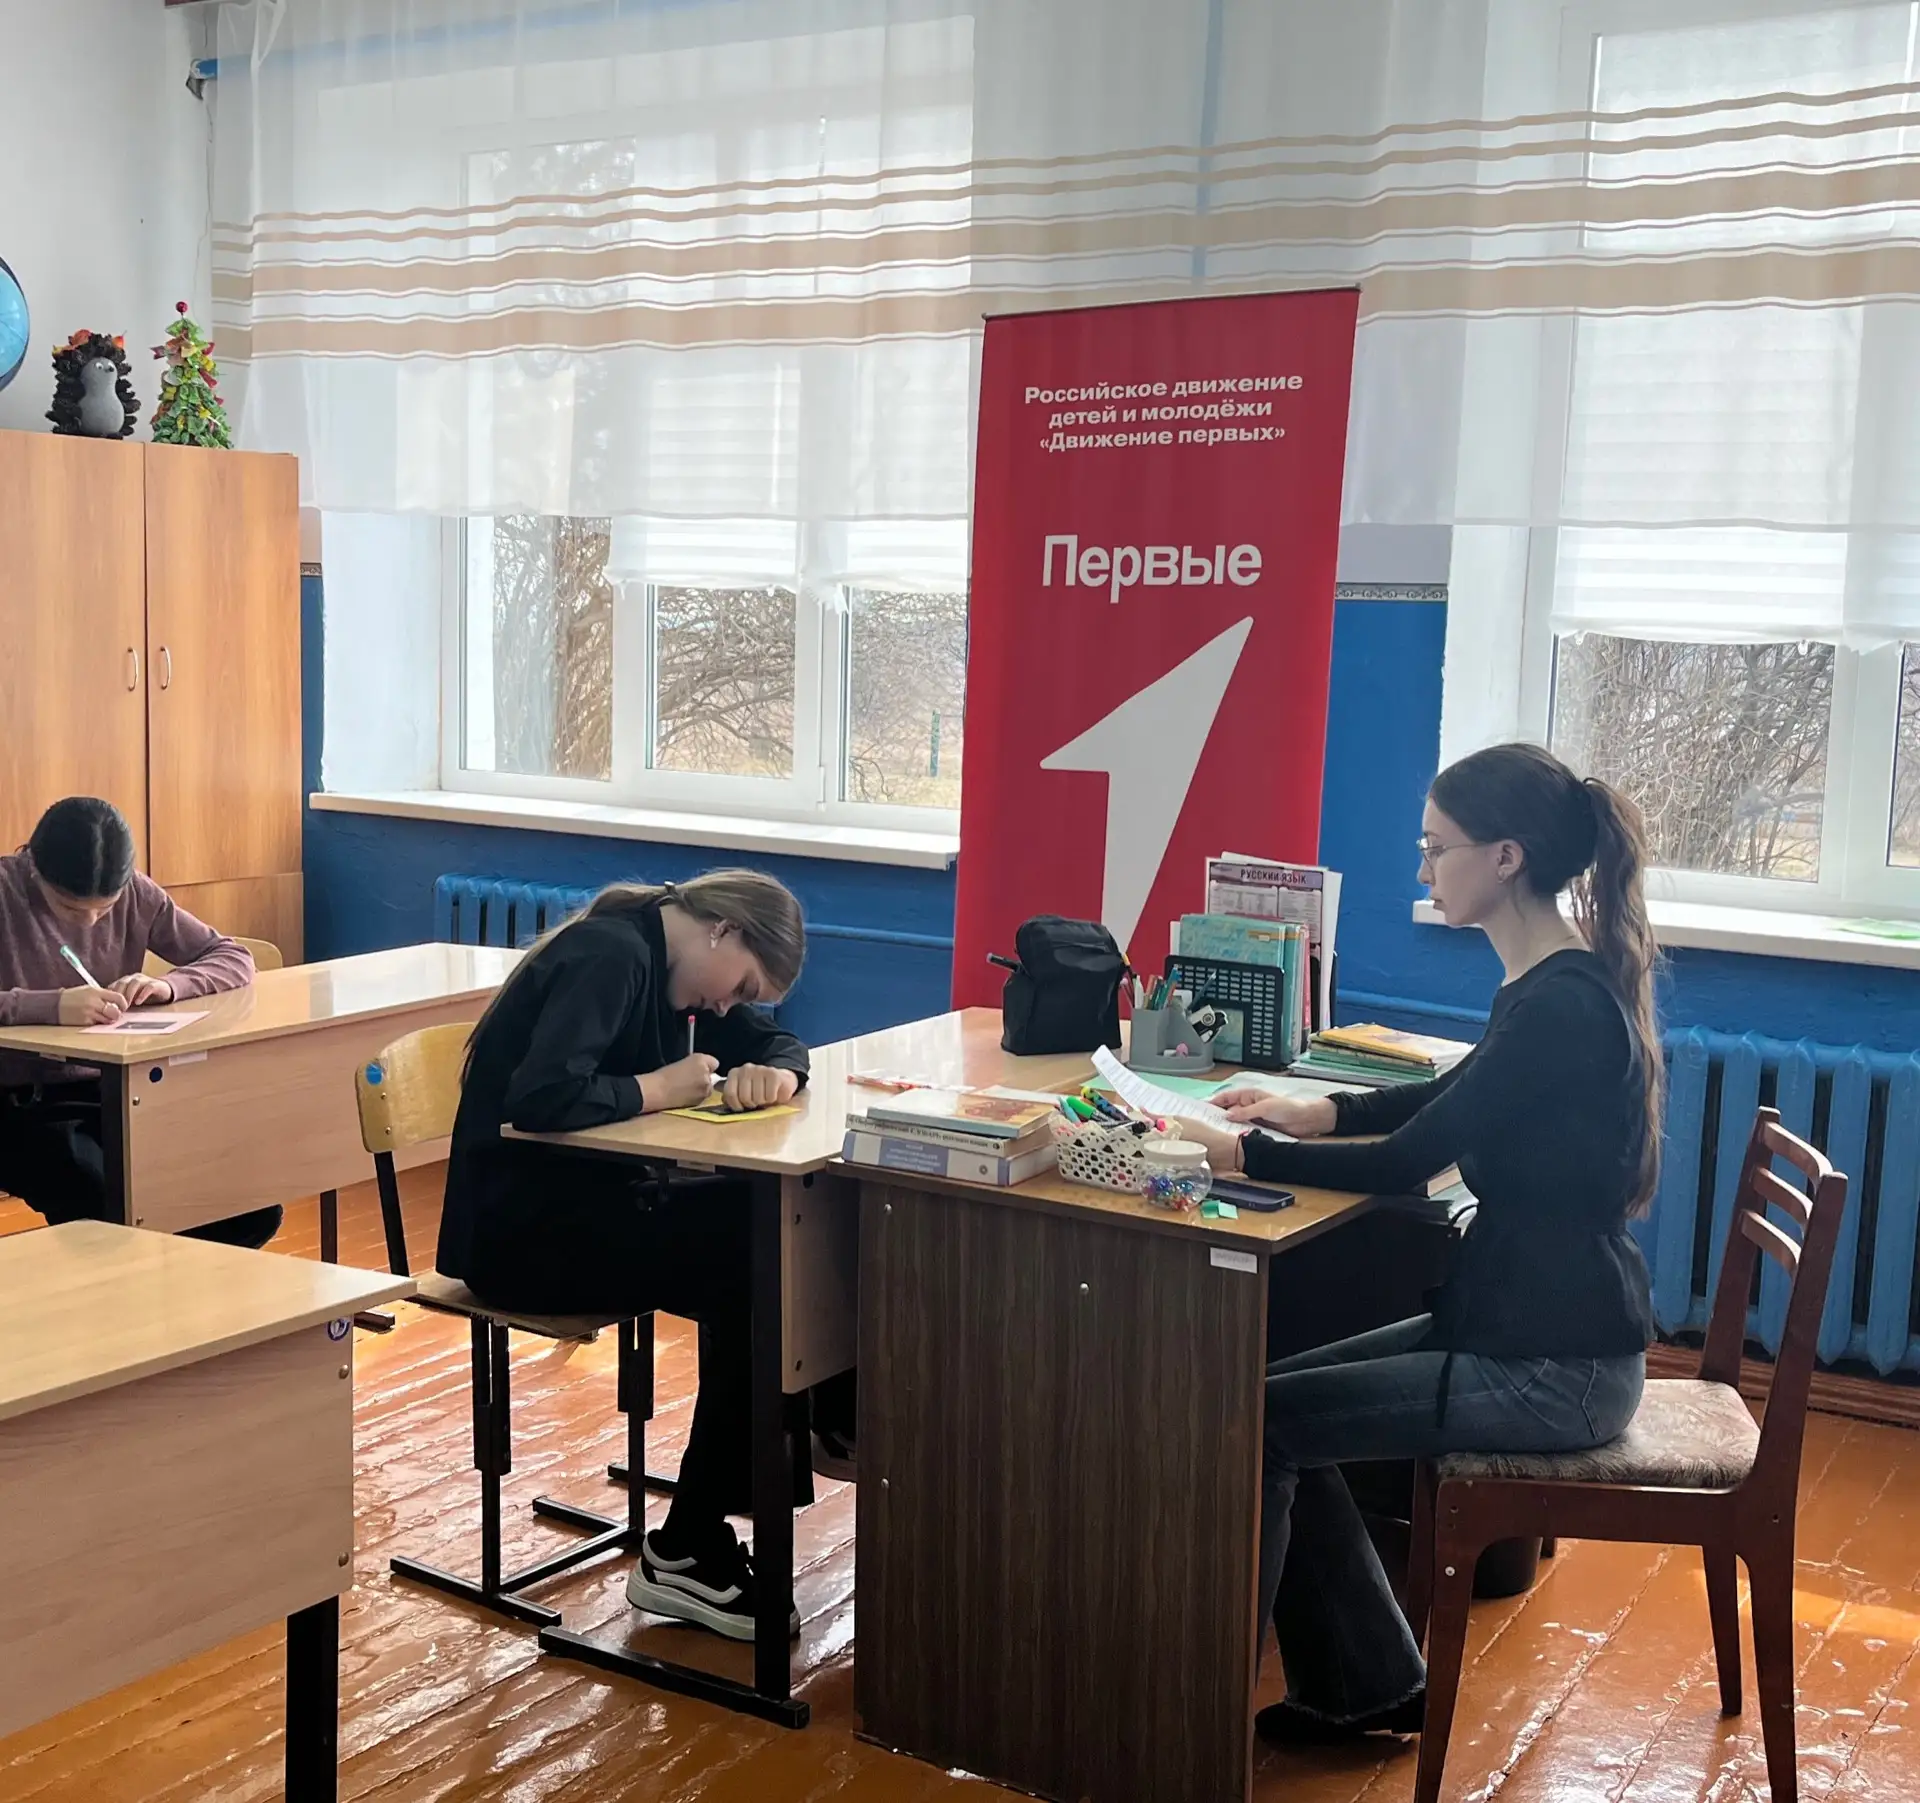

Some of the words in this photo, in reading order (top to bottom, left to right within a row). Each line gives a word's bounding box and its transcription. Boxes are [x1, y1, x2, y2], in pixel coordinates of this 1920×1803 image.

[1025, 382, 1167, 403] Российское
[1172, 375, 1303, 398] движение
[1049, 405, 1116, 428] детей
[1122, 406, 1137, 423] и
[1141, 399, 1273, 421] молодёжи
[1040, 430, 1173, 452] «Движение
[1178, 426, 1285, 446] первых»
[1042, 534, 1262, 604] Первые
[1281, 873, 1307, 885] ЯЗЫК
